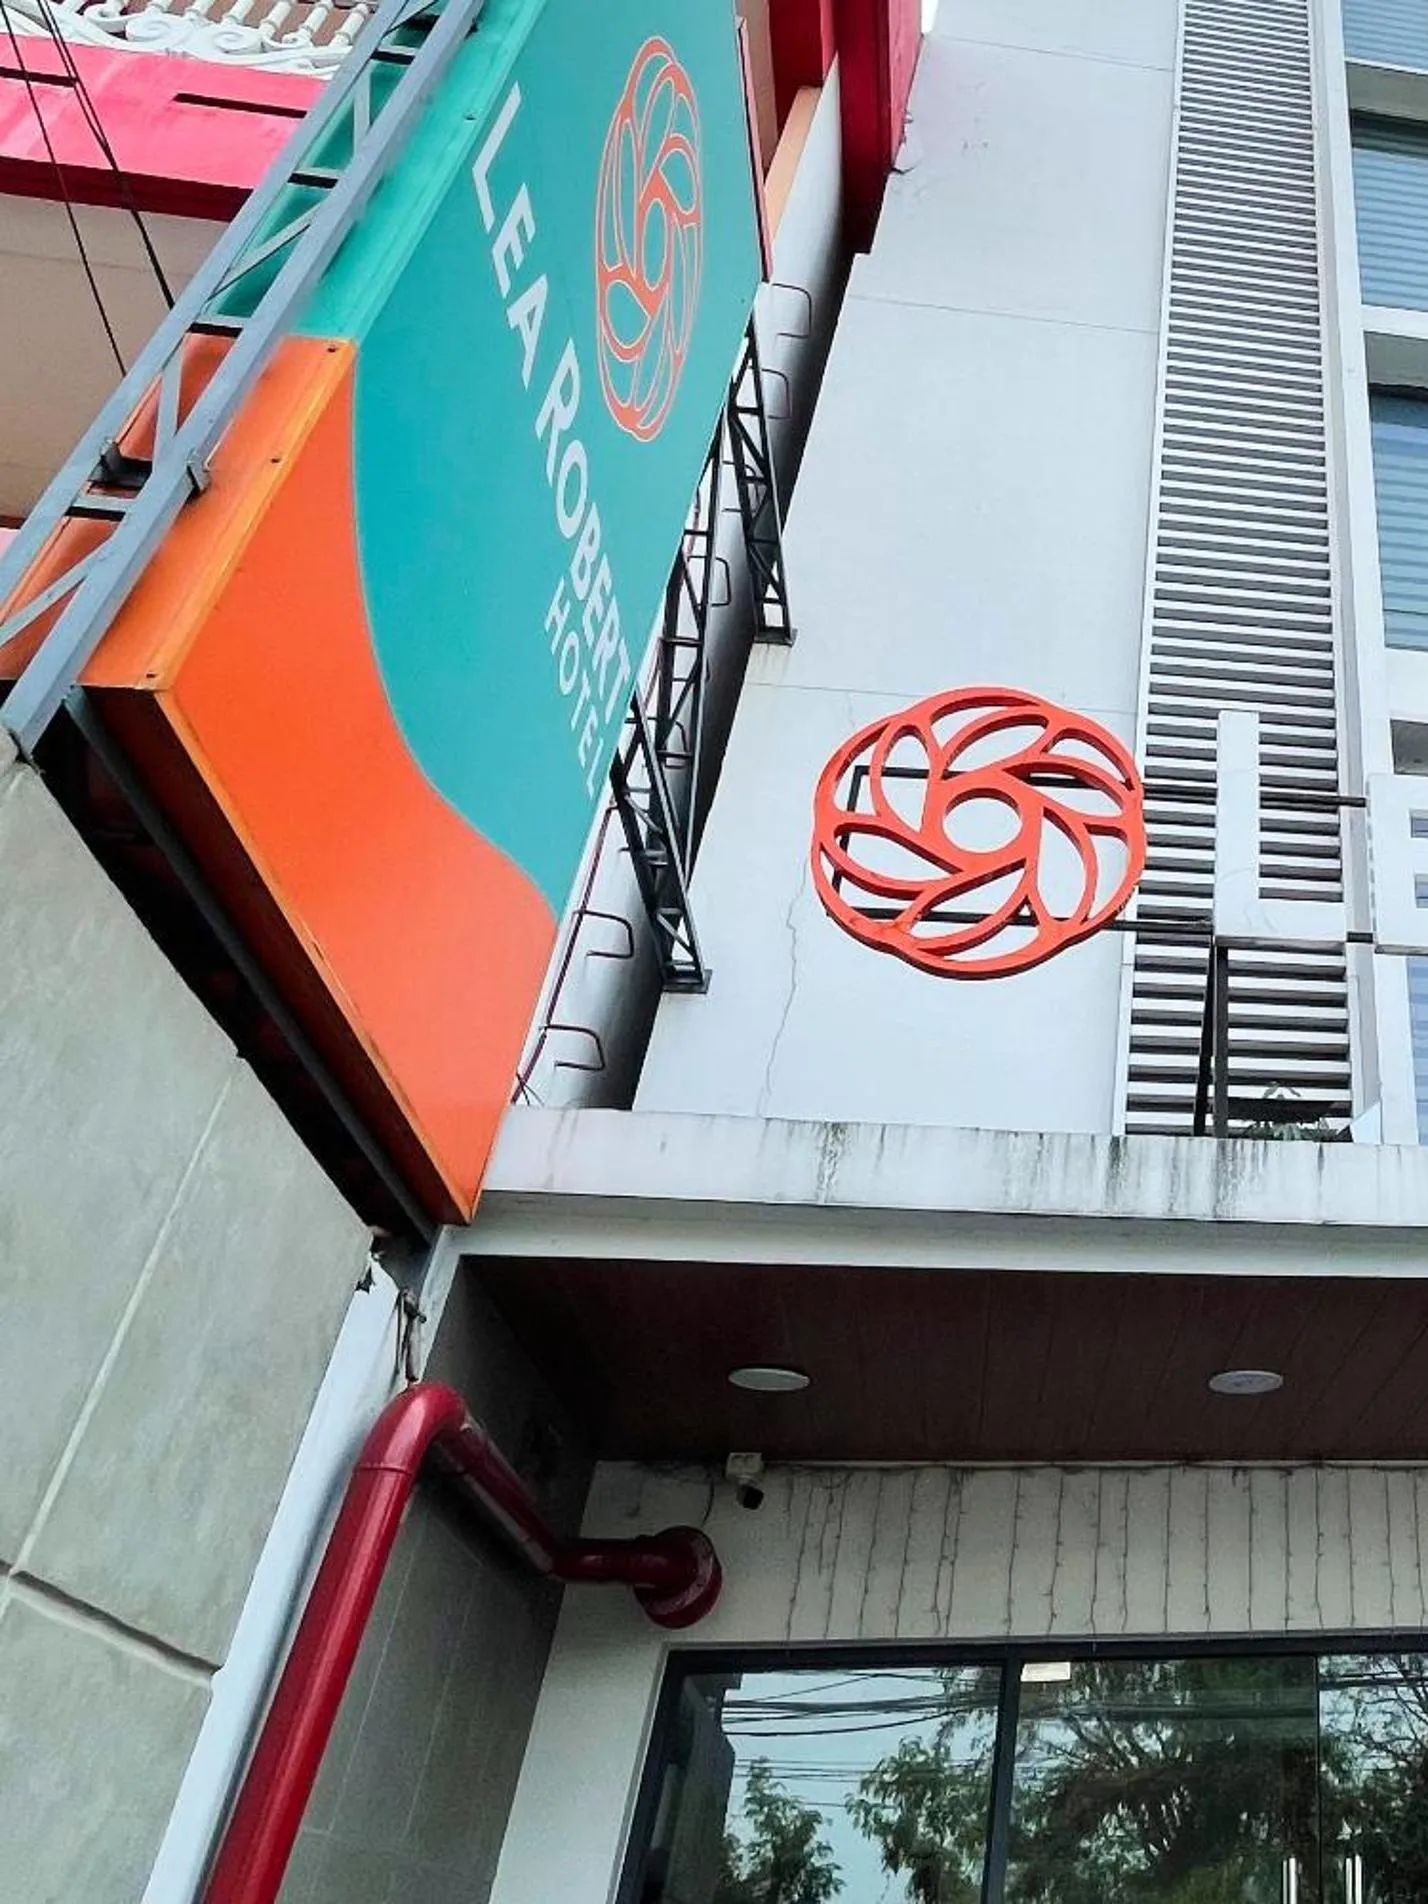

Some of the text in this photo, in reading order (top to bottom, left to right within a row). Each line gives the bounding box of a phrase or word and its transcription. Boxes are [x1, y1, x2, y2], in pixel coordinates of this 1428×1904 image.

[472, 83, 631, 725] LEA ROBERT
[544, 575, 604, 799] HOTEL
